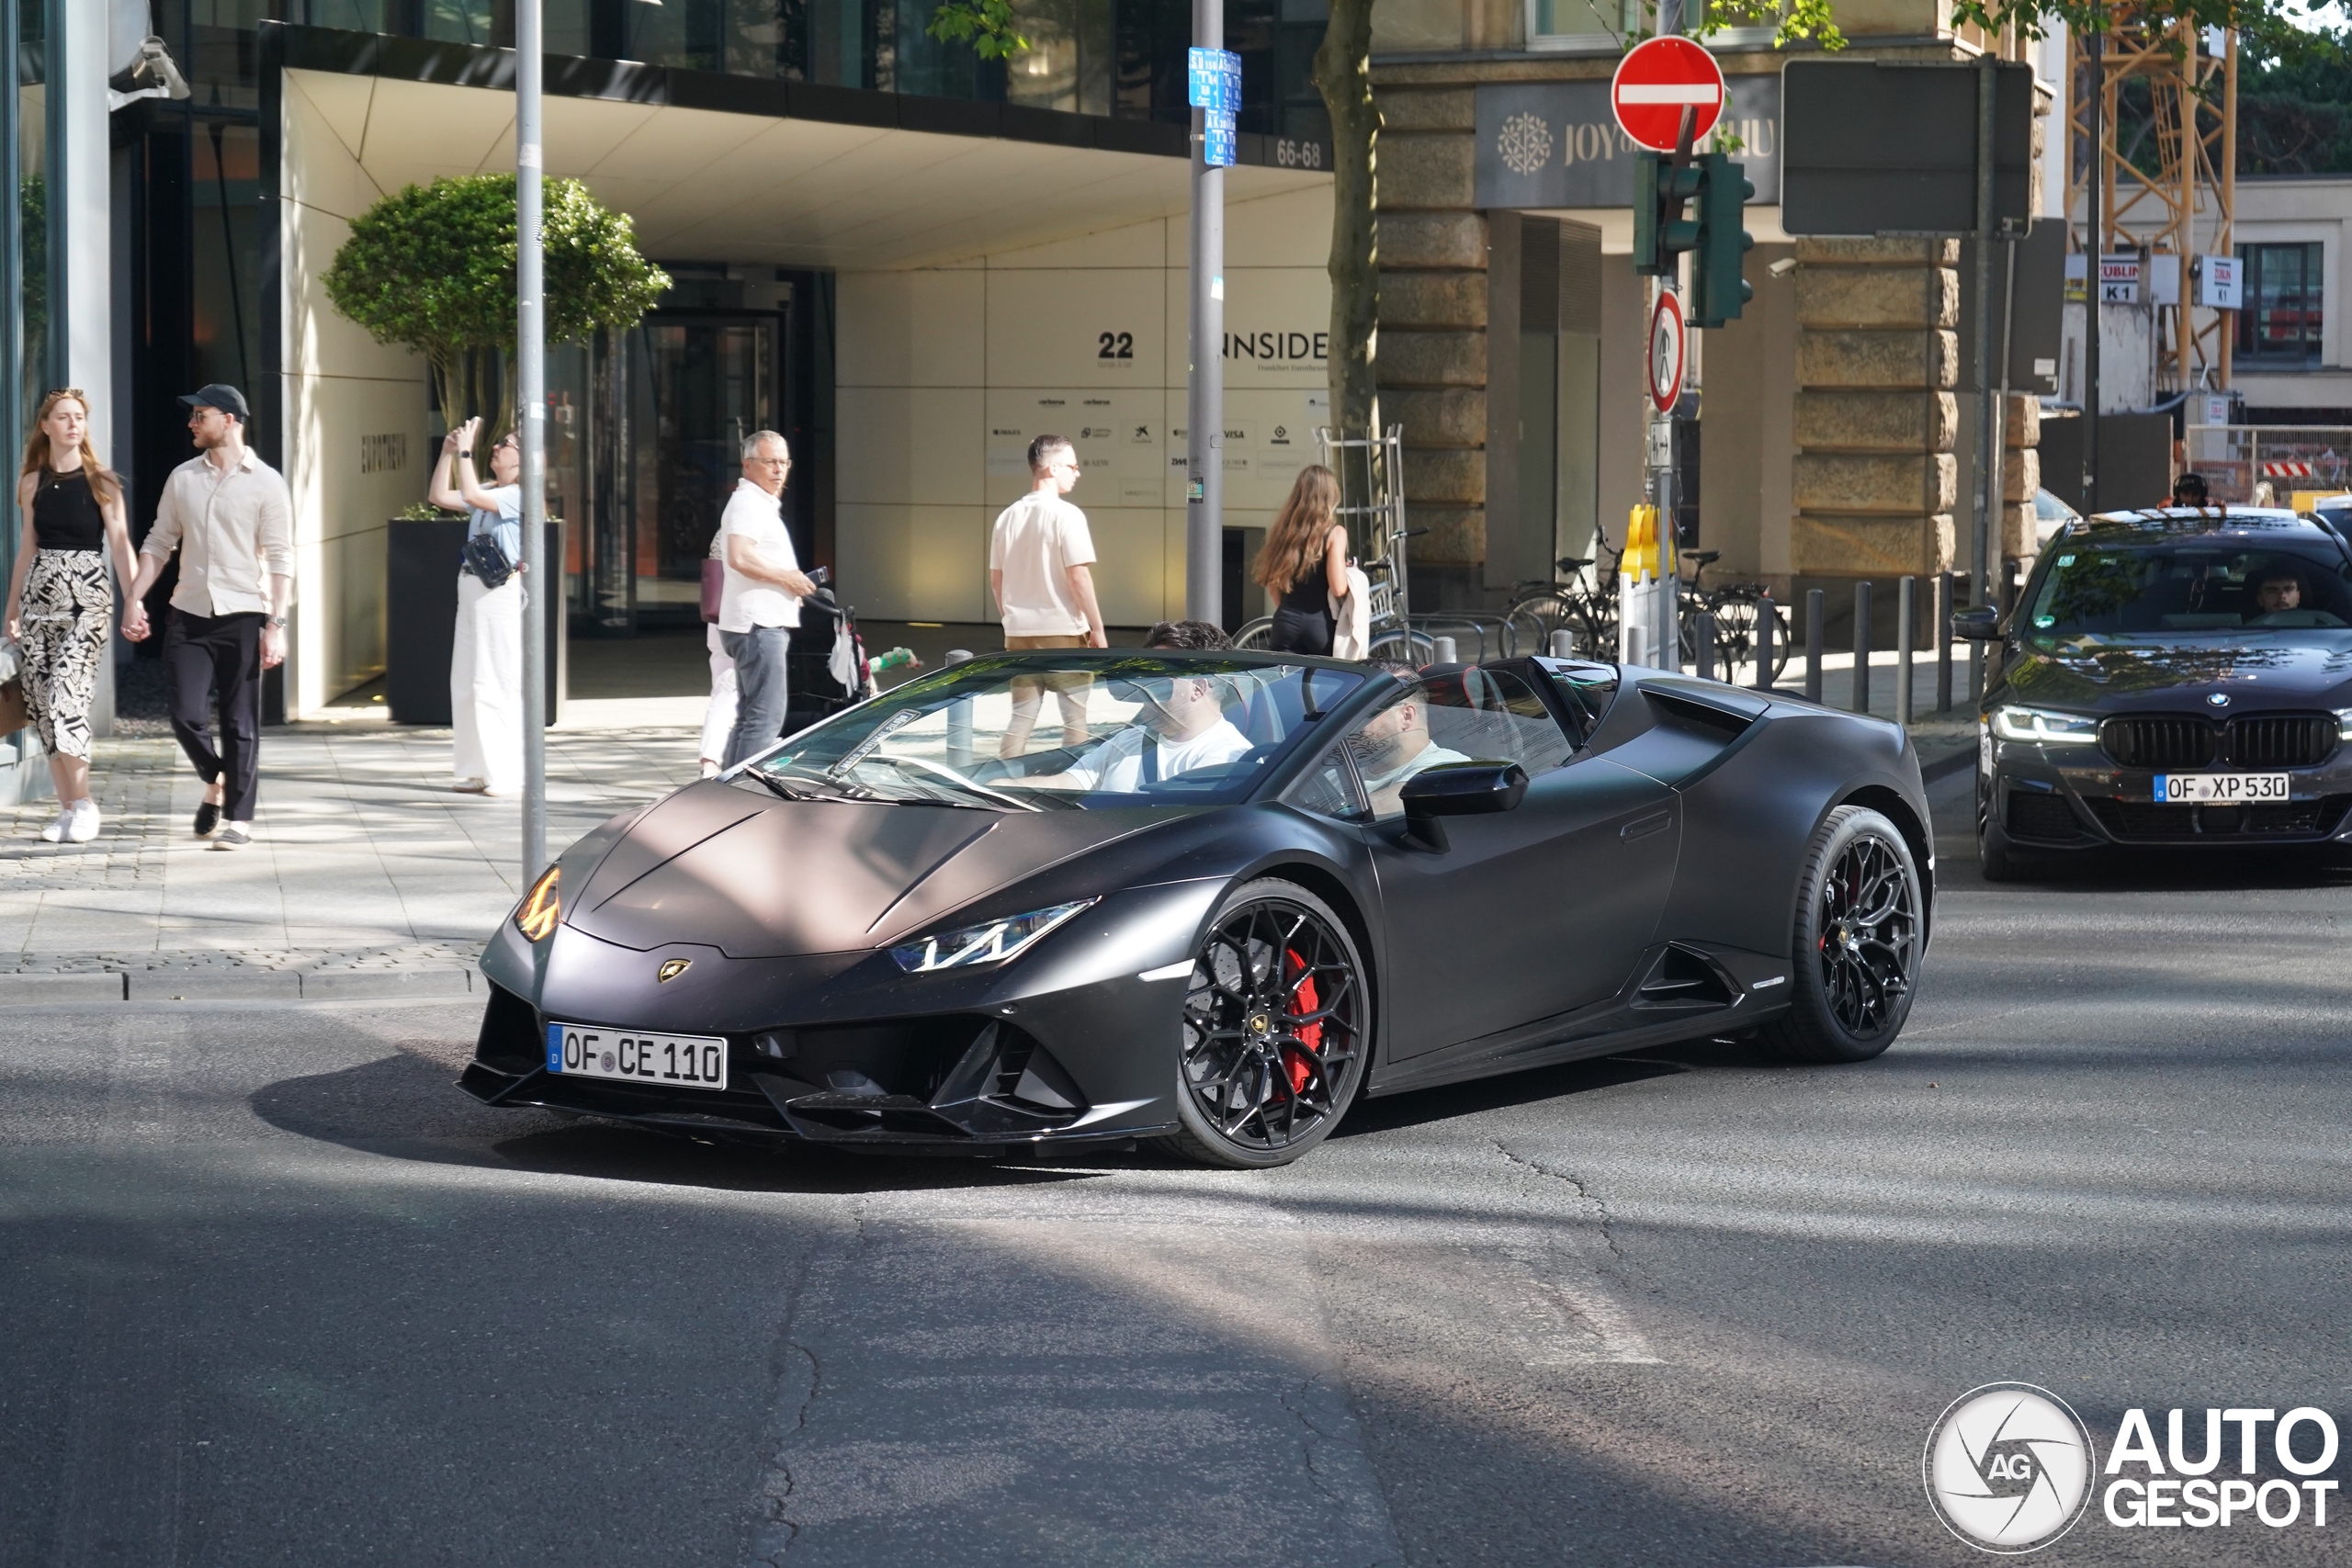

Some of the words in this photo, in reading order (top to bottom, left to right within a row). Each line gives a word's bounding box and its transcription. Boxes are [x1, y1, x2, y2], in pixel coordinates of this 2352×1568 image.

[1277, 139, 1321, 168] 66-68
[1563, 122, 1618, 166] JOY
[1098, 332, 1133, 359] 22
[1222, 333, 1328, 359] NSIDE
[1224, 430, 1245, 438] VISA
[2168, 778, 2197, 798] OF
[565, 1032, 599, 1070] OF
